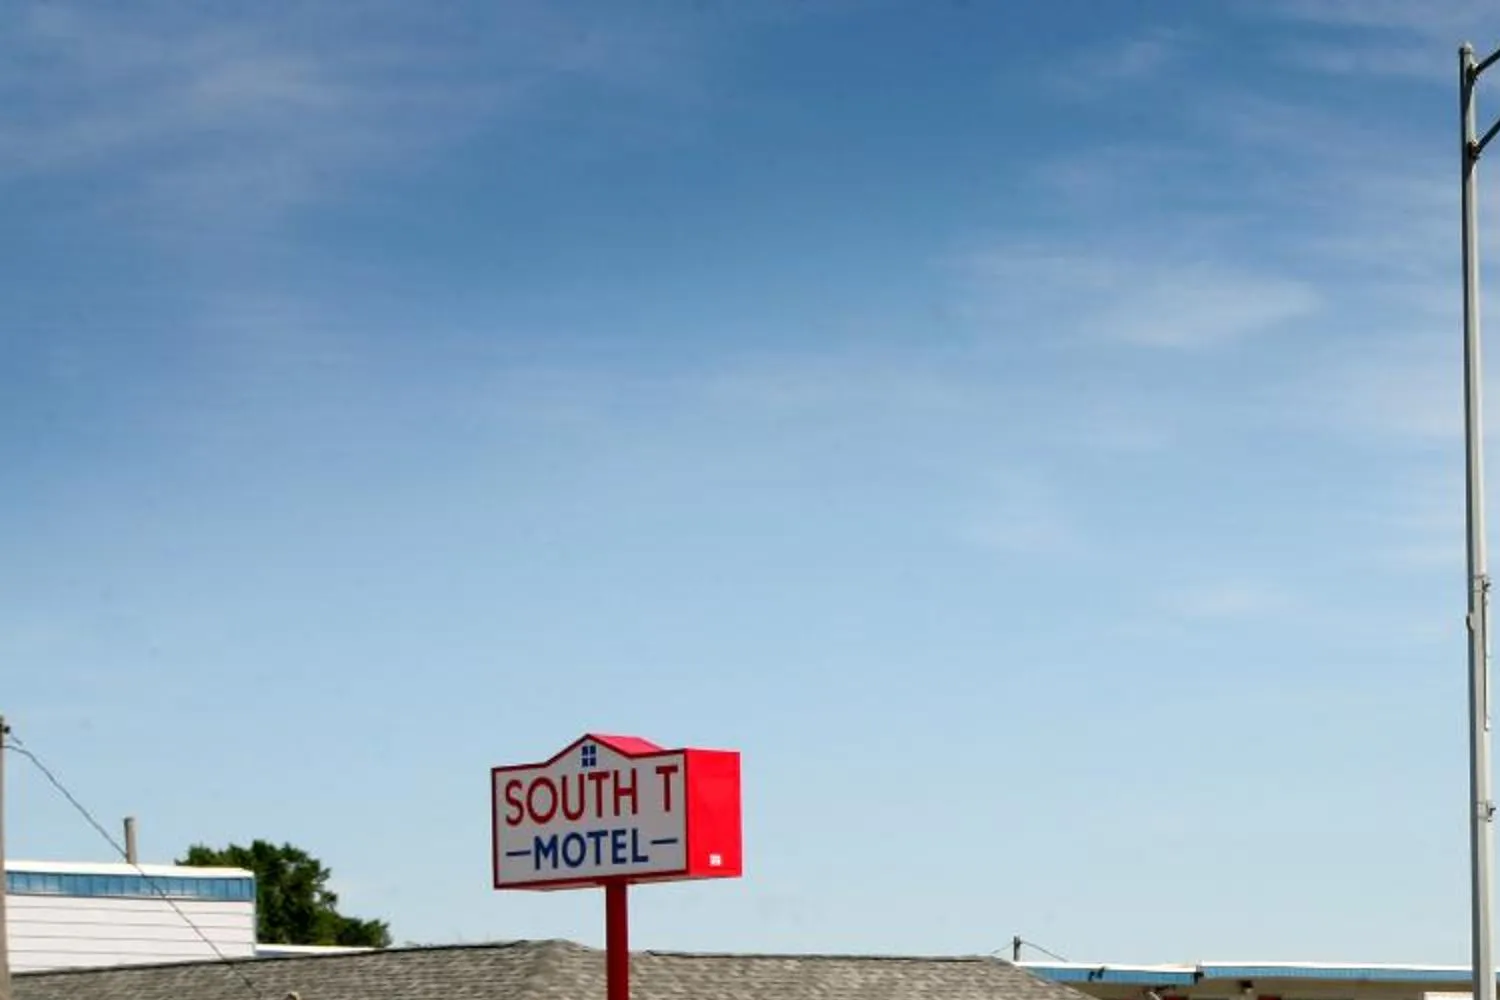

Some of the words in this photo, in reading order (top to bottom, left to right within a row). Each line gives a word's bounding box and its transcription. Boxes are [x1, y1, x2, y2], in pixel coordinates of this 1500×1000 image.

[505, 767, 638, 826] SOUTH
[655, 764, 678, 812] T
[534, 828, 648, 870] MOTEL
